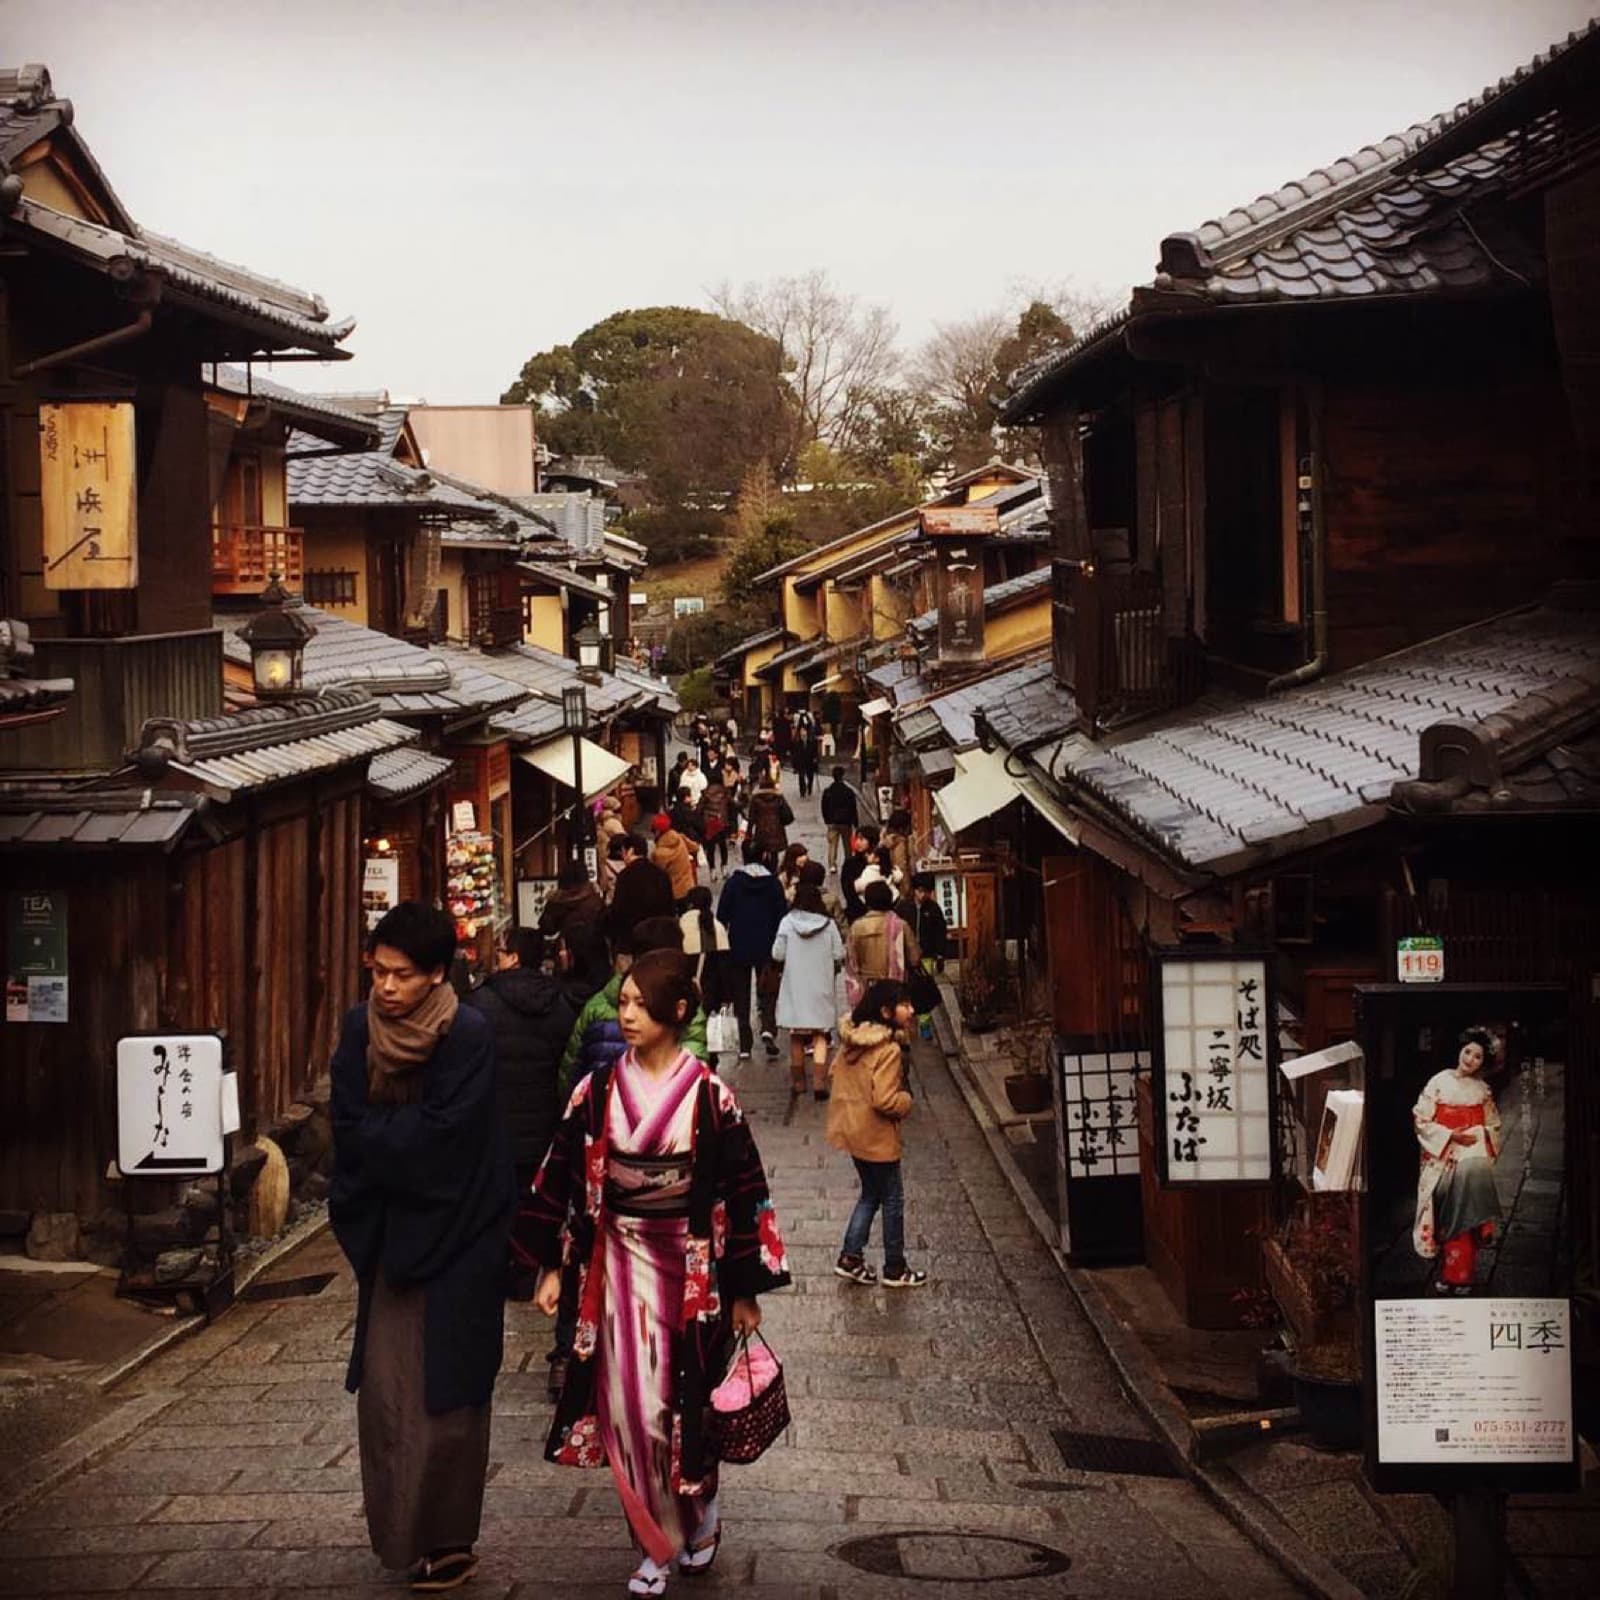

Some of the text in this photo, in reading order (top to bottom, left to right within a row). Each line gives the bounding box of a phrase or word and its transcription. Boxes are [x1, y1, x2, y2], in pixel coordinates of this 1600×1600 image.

[22, 896, 53, 911] TEA
[1402, 954, 1441, 972] 119
[1237, 978, 1263, 1060] そば処
[1206, 1030, 1233, 1112] 二寧坂
[1170, 1071, 1207, 1162] ふたば
[1490, 1320, 1565, 1354] 四季
[1473, 1420, 1567, 1433] 075-531-2777
